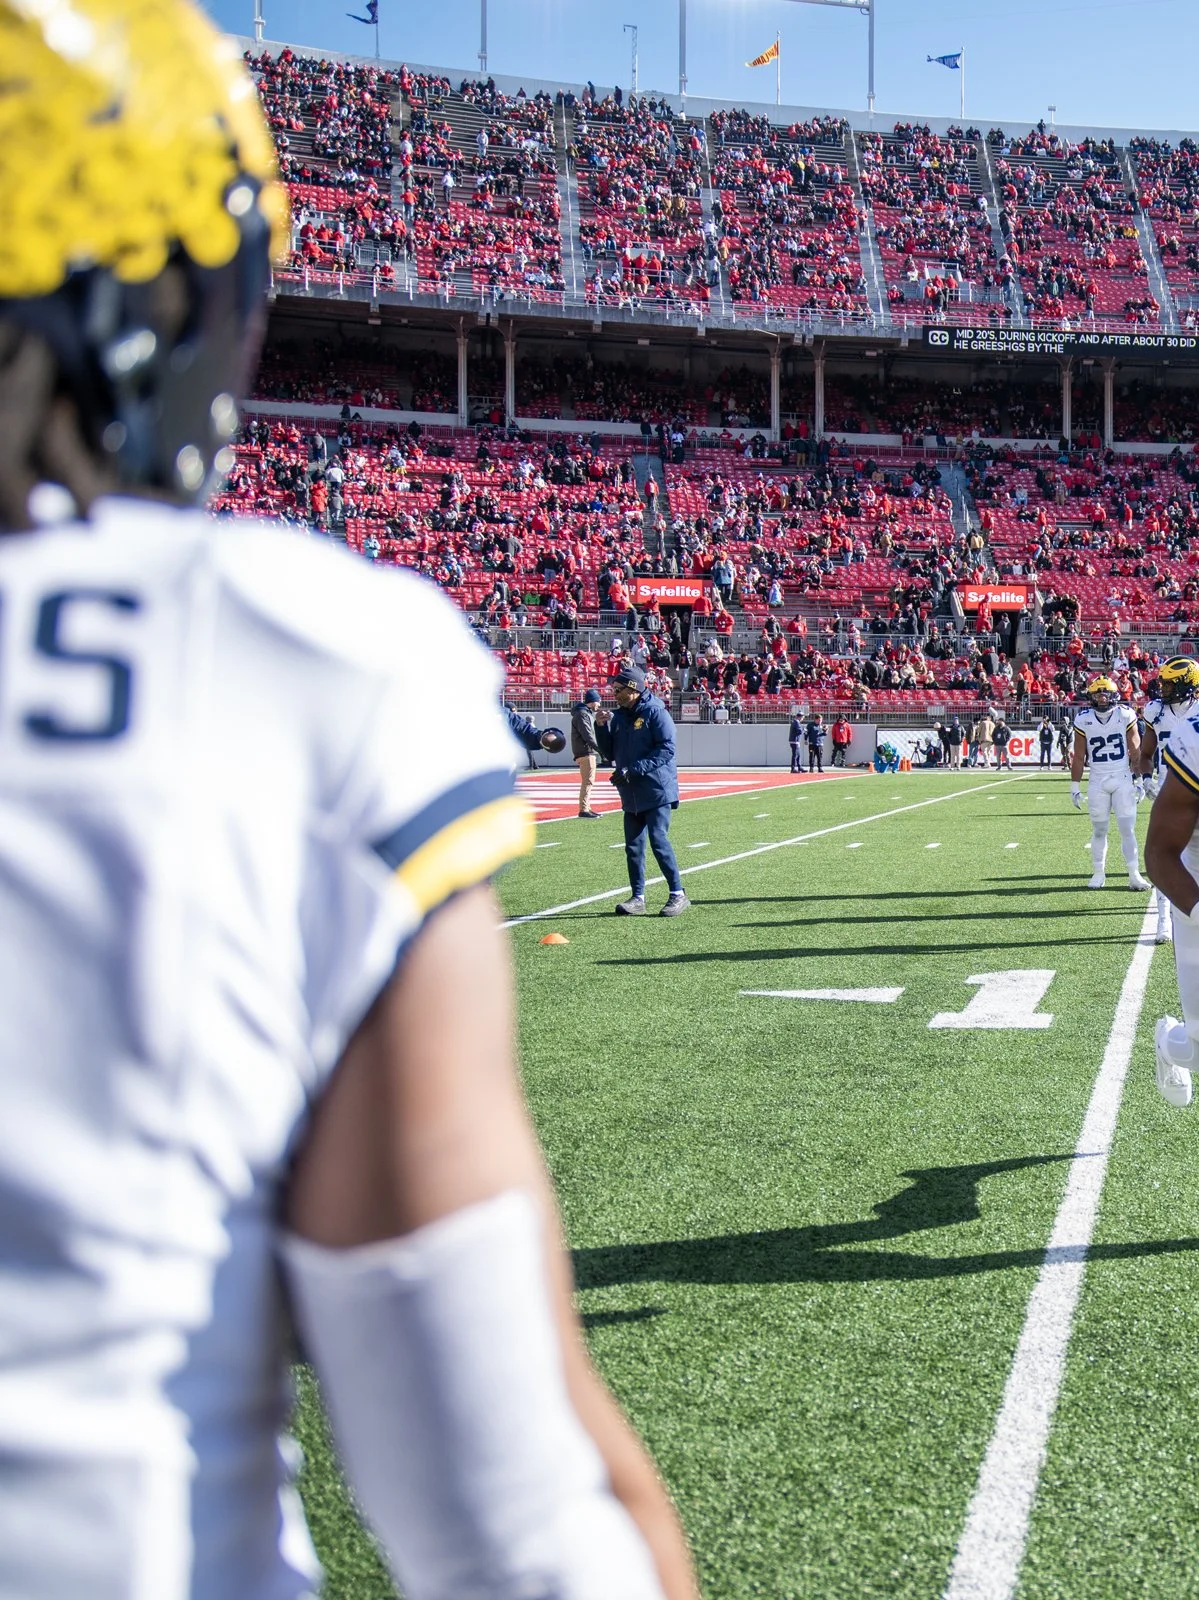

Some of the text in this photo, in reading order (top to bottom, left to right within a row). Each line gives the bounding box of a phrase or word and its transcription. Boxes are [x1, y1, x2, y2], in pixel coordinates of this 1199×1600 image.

[930, 332, 948, 344] CC
[956, 329, 1196, 348] MID 20'S, DURING KICKOFF, AND AFTER ABOUT 30 DID
[954, 340, 1064, 353] HE GREESHGS BY THE
[639, 585, 700, 597] Safelite
[1089, 733, 1125, 762] 23
